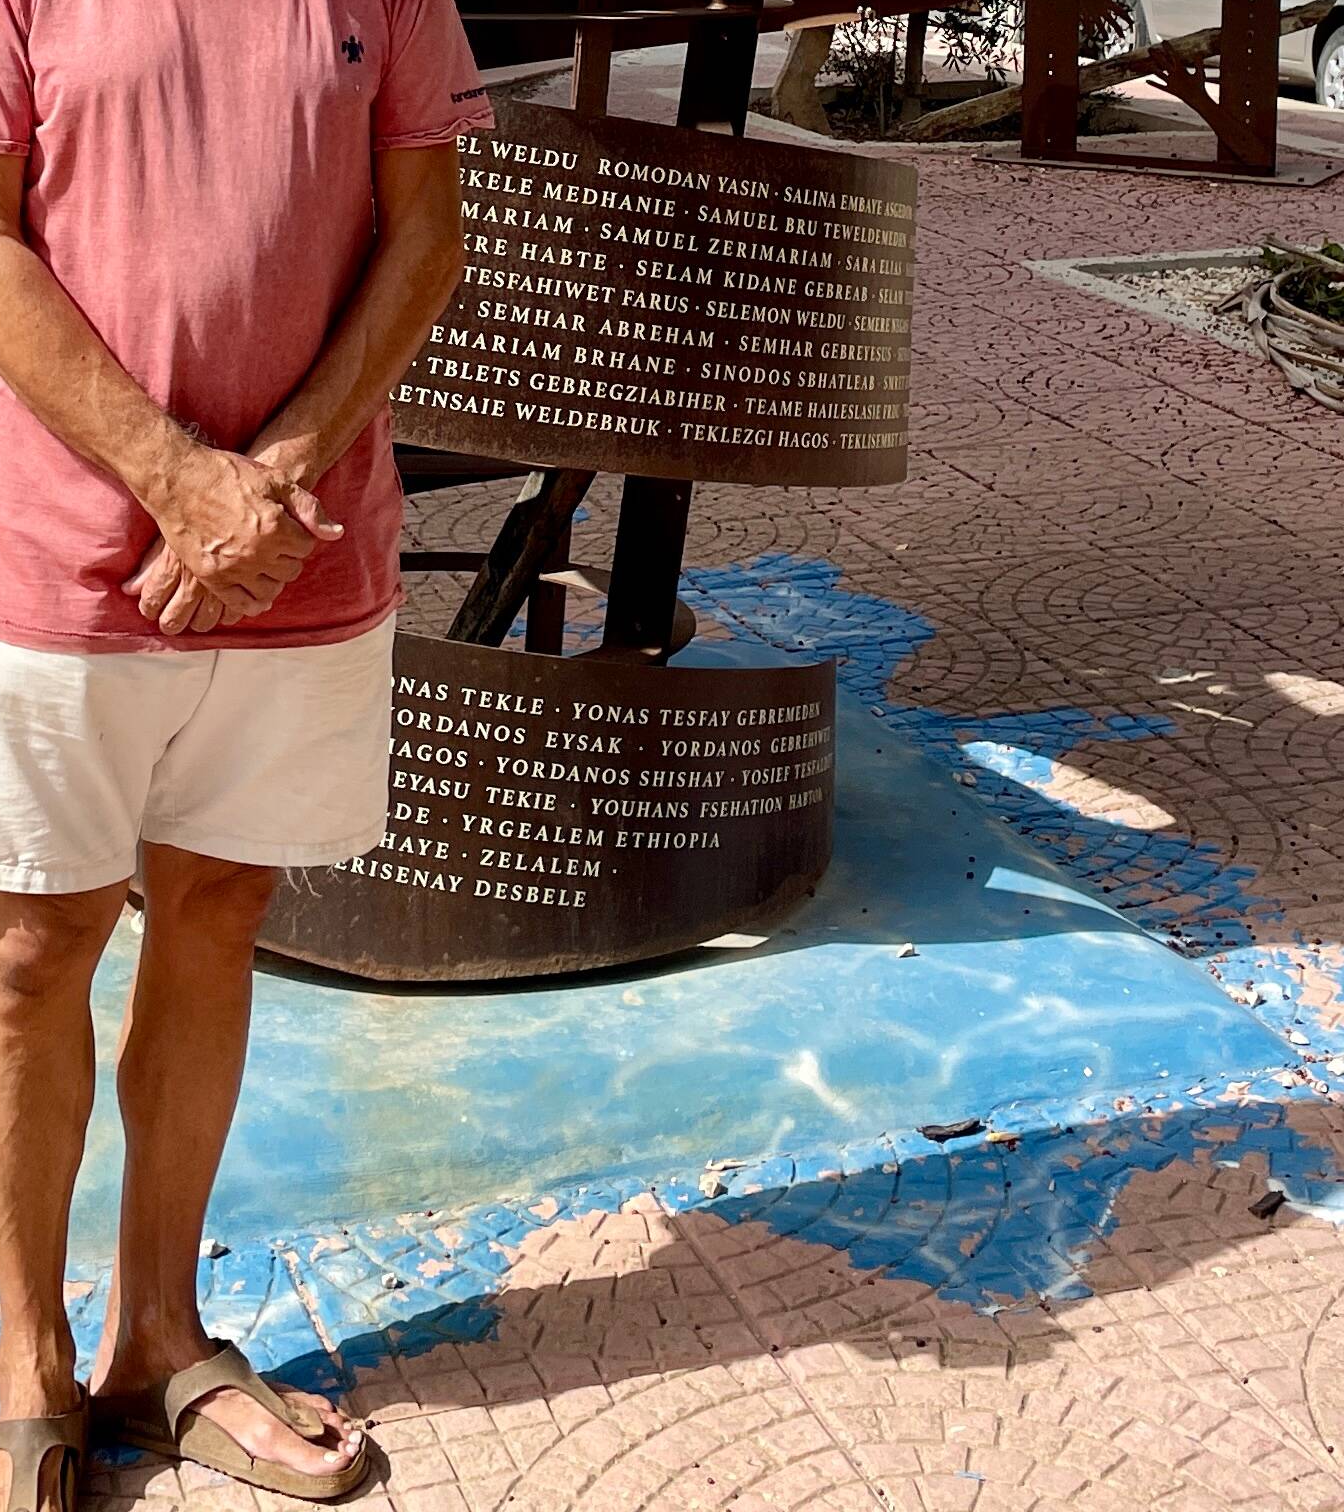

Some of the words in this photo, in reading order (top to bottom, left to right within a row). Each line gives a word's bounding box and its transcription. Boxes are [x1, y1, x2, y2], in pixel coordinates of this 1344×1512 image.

[491, 141, 577, 169] WELDU
[598, 158, 710, 190] ROMODAN
[718, 177, 769, 198] YASIN
[543, 182, 675, 217] MEDHANIE
[698, 205, 778, 231] SAMUEL
[785, 217, 817, 236] BRU
[600, 223, 698, 251] SAMUEL
[708, 238, 832, 268] ZERIMARIAM
[521, 243, 606, 270] HABTE
[636, 260, 712, 285] SELAM
[724, 271, 797, 294] KIDANE
[622, 290, 688, 313] FARUS
[706, 301, 791, 324] SELEMON
[478, 301, 585, 332] SEMHAR
[598, 319, 714, 348] ABREHAM
[739, 336, 812, 357] SEMHAR
[574, 347, 675, 375] BRHANE
[701, 363, 791, 386] SINODOS
[428, 357, 520, 386] TBLETS
[530, 373, 725, 411] GEBREGZIABIHER
[745, 398, 802, 417] TEAME
[515, 403, 660, 436] WELDEBRUK
[680, 423, 773, 446] TEKLEZGI
[461, 688, 543, 715] TEKLE
[572, 703, 649, 724] YONAS
[660, 710, 730, 727] TESFAY
[545, 731, 622, 753] EYSAK
[662, 739, 760, 757] YORDANOS
[497, 757, 630, 785] YORDANOS
[639, 771, 724, 787] SHISHAY
[486, 787, 556, 810] TEKIE
[592, 798, 688, 818] YOUHANS
[463, 814, 603, 846] YRGEALEM
[616, 831, 719, 848] ETHIOPIA
[480, 849, 600, 877] ZELALEM
[474, 880, 586, 907] DESBELE
